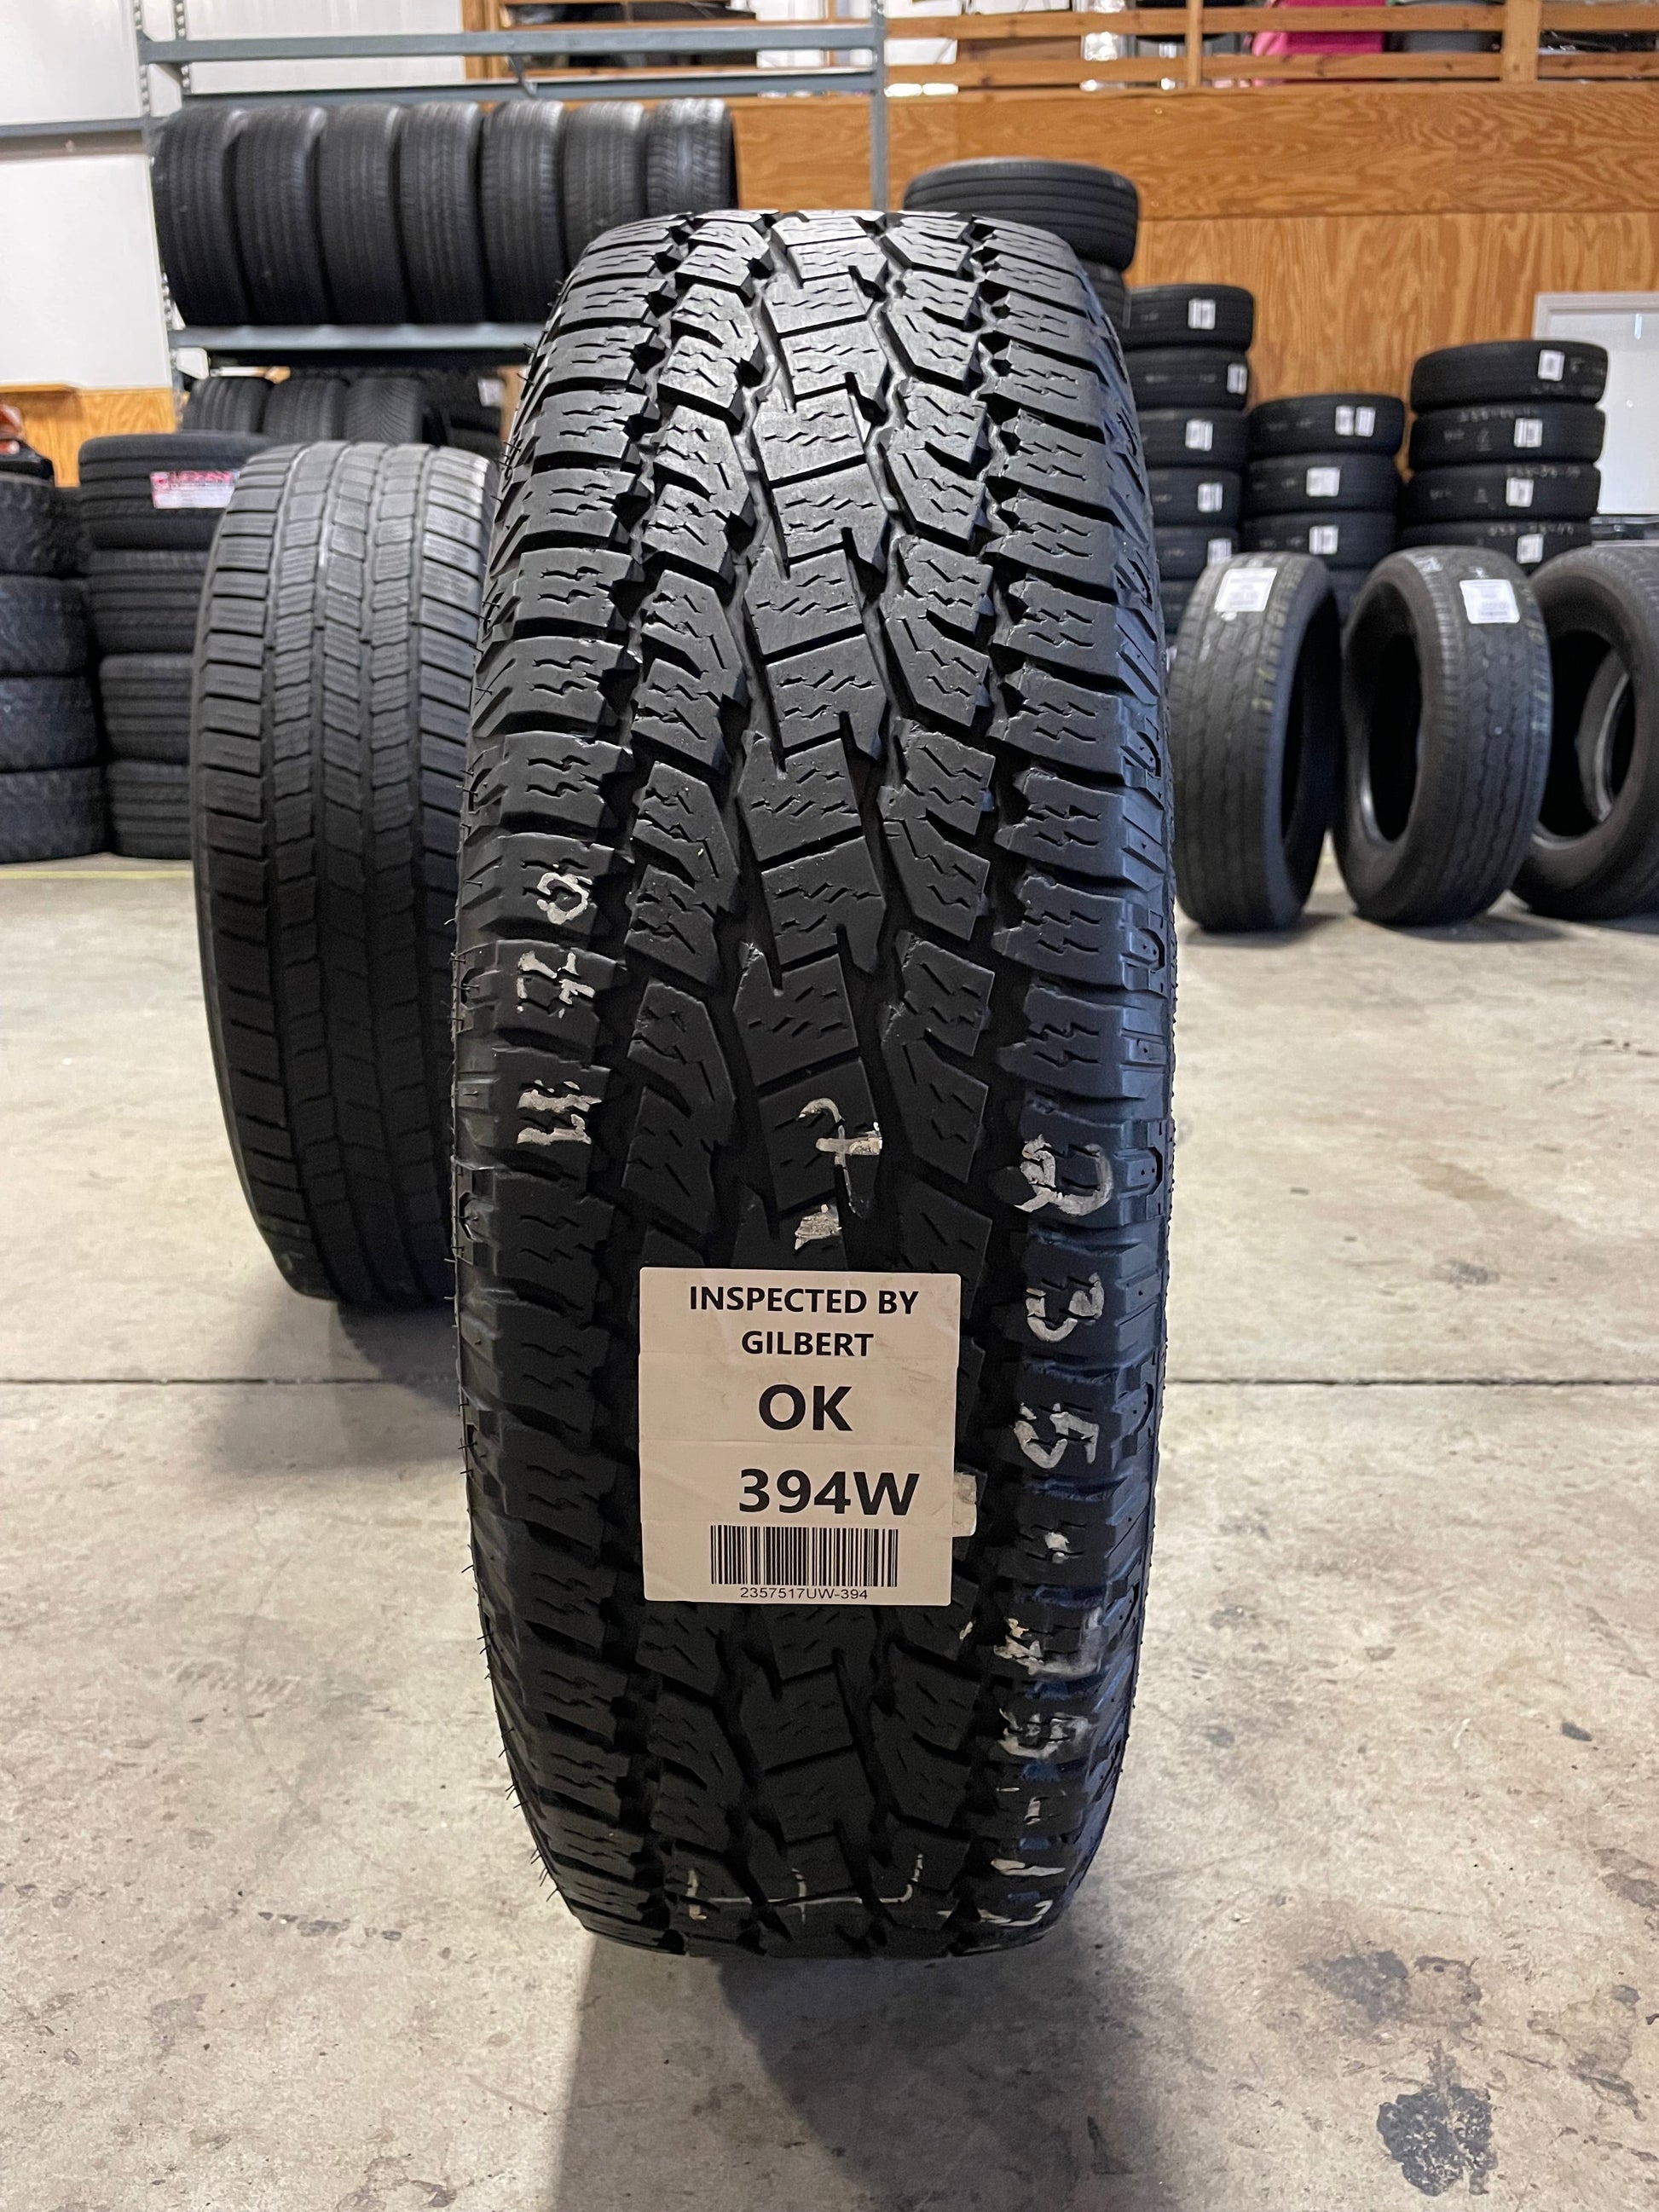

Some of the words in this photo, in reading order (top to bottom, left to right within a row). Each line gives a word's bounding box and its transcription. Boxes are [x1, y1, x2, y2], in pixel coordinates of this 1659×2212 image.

[691, 1286, 866, 1313] INSPECTED
[879, 1291, 918, 1314] BY
[743, 1331, 874, 1356] GILBERT
[759, 1384, 852, 1431] OK
[740, 1469, 919, 1516] 394W
[741, 1587, 867, 1599] 2357517UW-394
